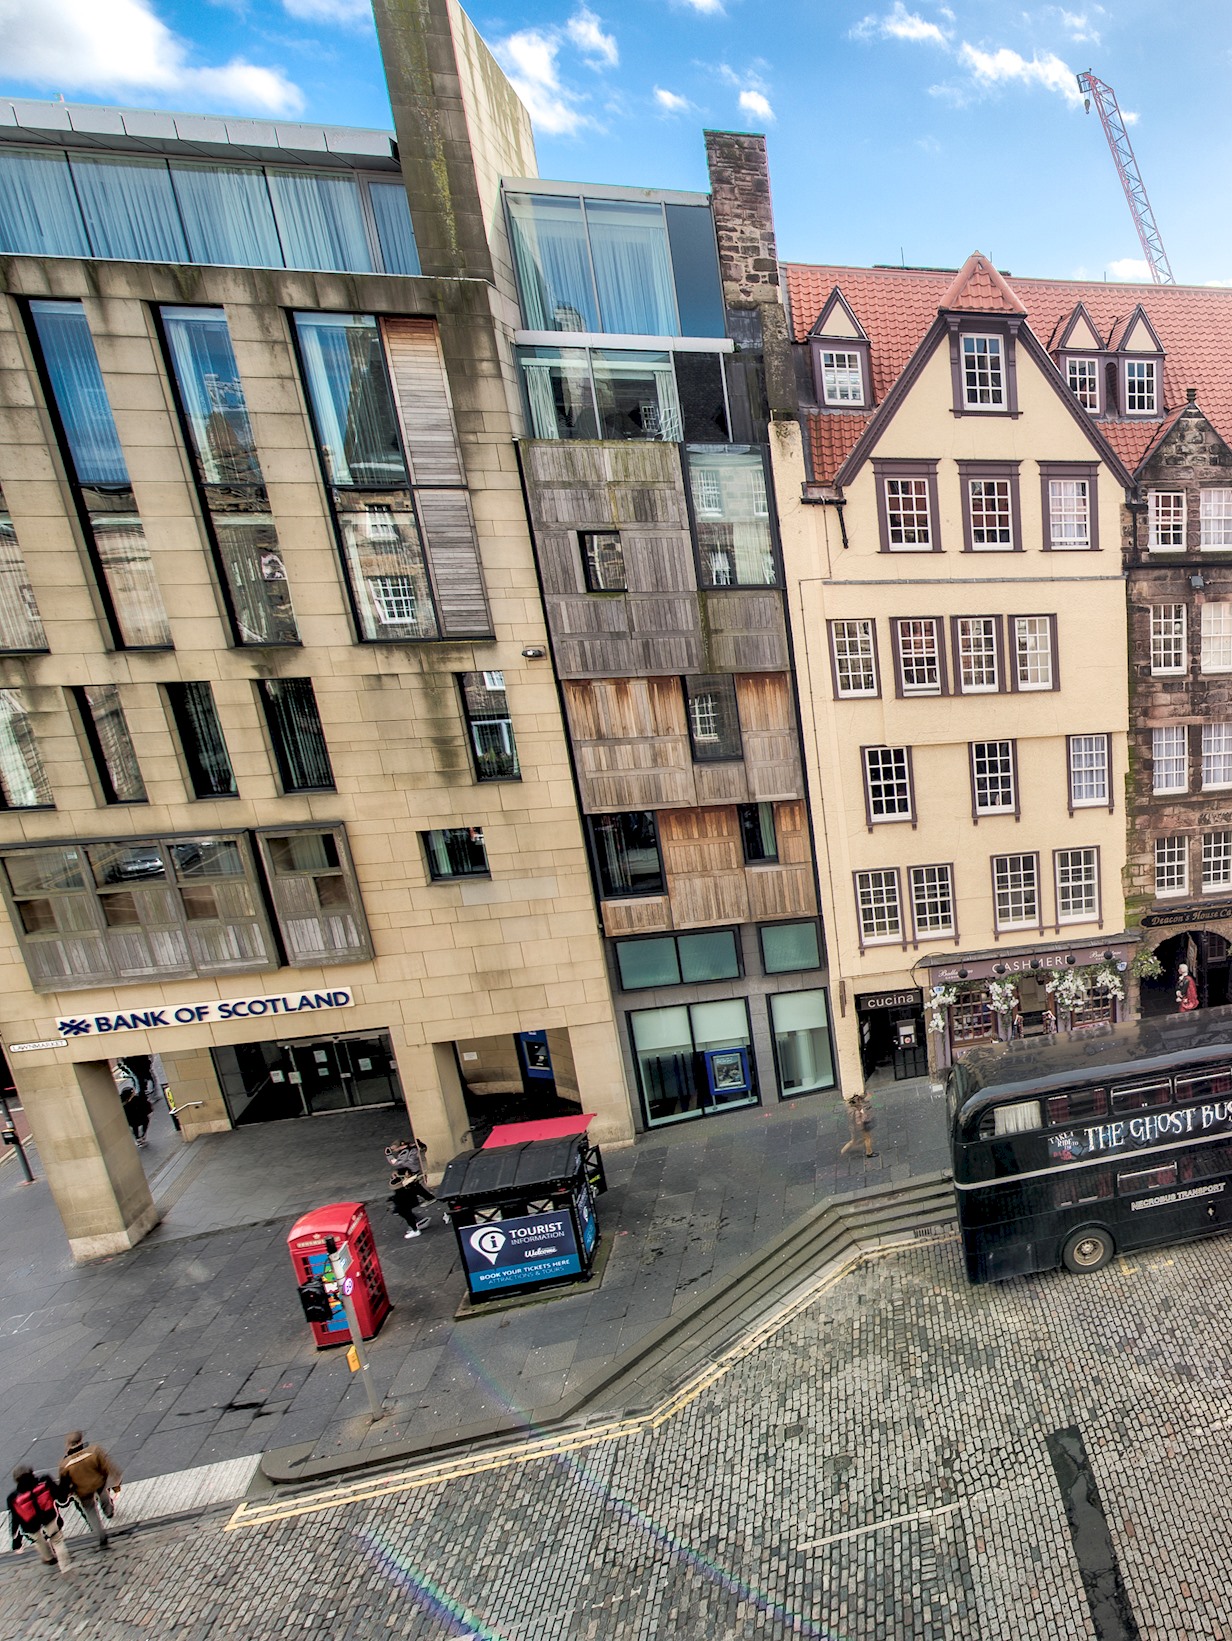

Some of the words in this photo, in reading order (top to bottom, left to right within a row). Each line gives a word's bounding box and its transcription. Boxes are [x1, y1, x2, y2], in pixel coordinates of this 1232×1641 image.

[1151, 913, 1190, 926] Deacon's
[1192, 910, 1219, 921] House
[867, 994, 914, 1008] cucina
[94, 1010, 170, 1033] BANK
[174, 1005, 210, 1024] OF
[217, 991, 351, 1019] SCOTLAND
[12, 1040, 65, 1052] LAWNMARKET
[1084, 1121, 1126, 1152] THE
[1129, 1107, 1197, 1141] GHOST
[1131, 1193, 1176, 1211] NECROBUS
[1177, 1182, 1226, 1200] TRANSPORT
[509, 1221, 563, 1239] TOURIST
[511, 1231, 565, 1246] INFORMATION
[524, 1246, 558, 1258] Welcome
[479, 1272, 501, 1281] BOOK
[502, 1268, 522, 1277] YOUR
[524, 1262, 551, 1272] TICKETS
[552, 1259, 570, 1267] HERE
[488, 1272, 534, 1284] ATTRACTIONS
[541, 1266, 565, 1275] TOURS
